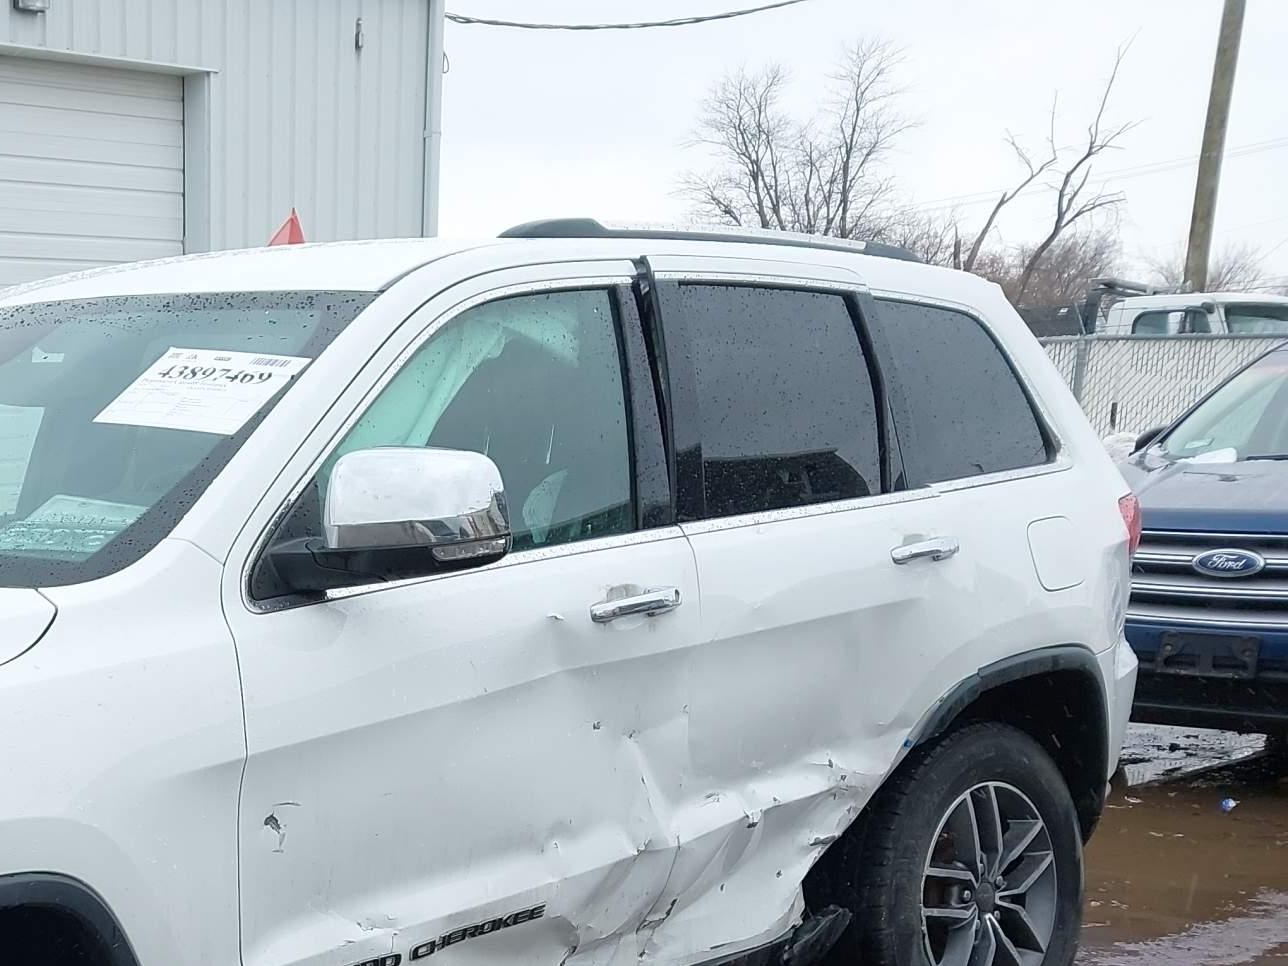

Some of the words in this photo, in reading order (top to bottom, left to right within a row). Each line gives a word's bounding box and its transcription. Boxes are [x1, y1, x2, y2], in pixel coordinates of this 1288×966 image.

[157, 364, 273, 385] 43897469
[1207, 553, 1248, 570] Ford
[408, 900, 547, 962] CHEROKEE
